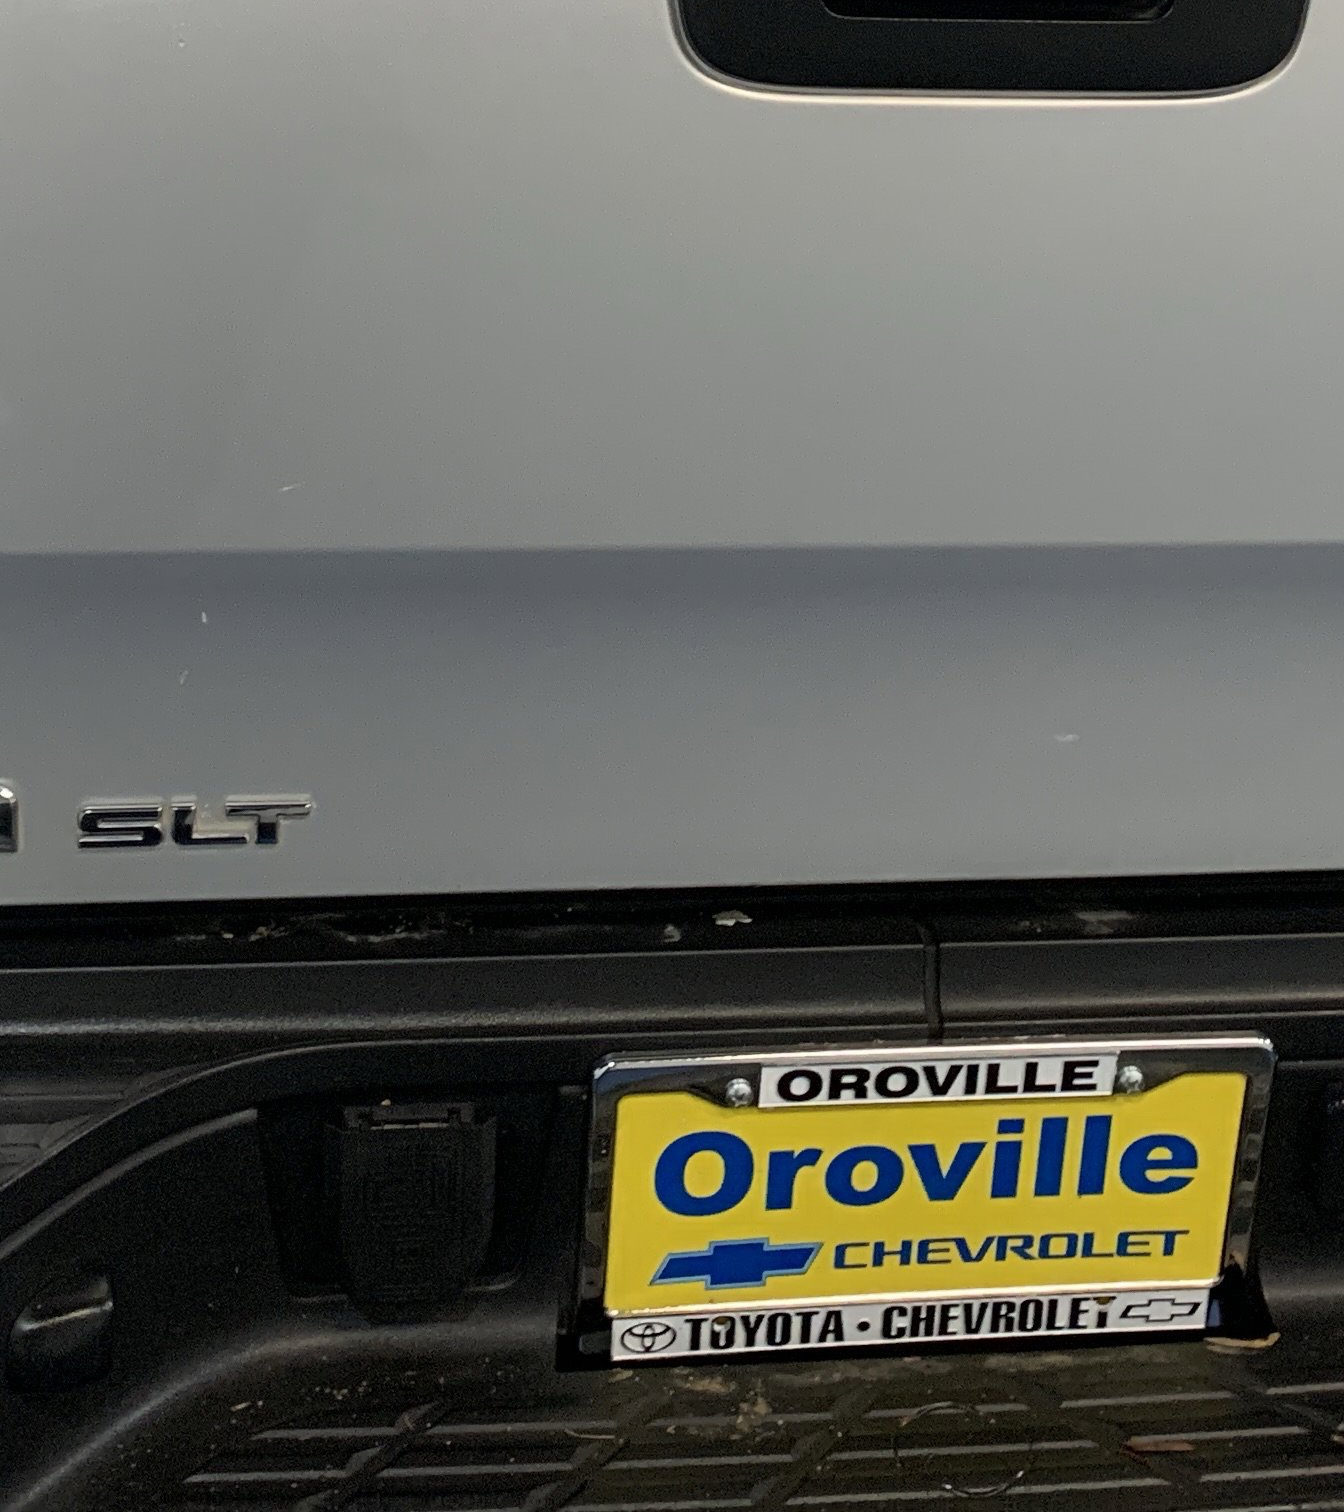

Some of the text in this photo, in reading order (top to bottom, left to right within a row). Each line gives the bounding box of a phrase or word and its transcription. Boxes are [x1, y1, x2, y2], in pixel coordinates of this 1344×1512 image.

[76, 795, 313, 851] SLT
[776, 1059, 1099, 1103] OROVILLE
[654, 1114, 1200, 1217] Oroville
[833, 1230, 1190, 1269] CHEVROLET
[685, 1295, 1117, 1351] TOYOTA CHEVROLET
